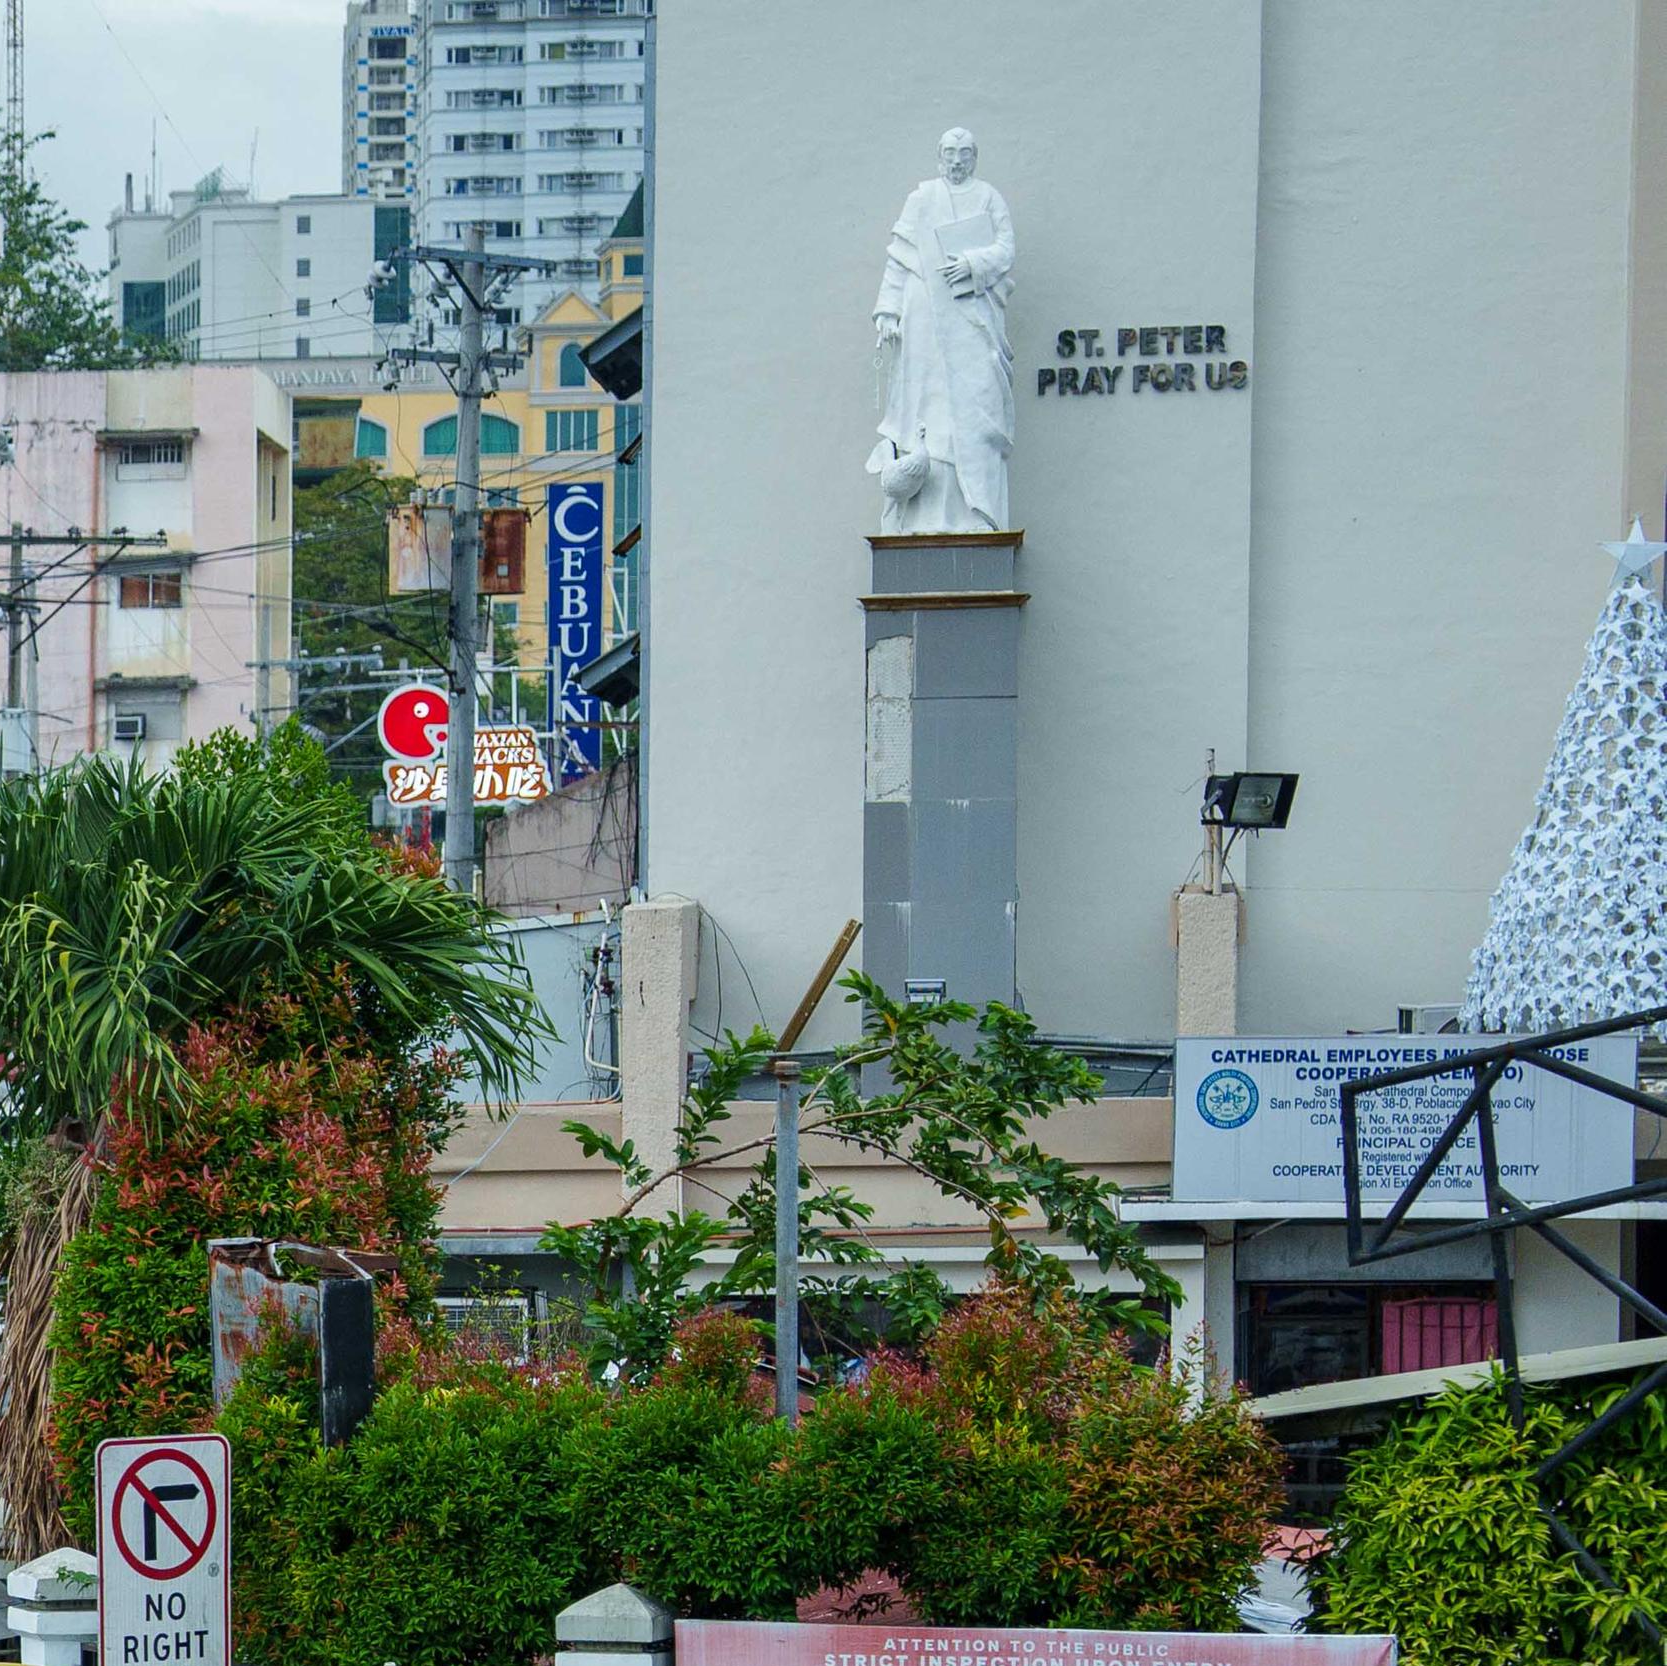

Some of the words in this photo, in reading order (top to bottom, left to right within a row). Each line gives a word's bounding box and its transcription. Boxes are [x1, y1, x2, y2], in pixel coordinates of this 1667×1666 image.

[1056, 330, 1104, 358] ST.
[1118, 325, 1226, 356] PETER
[1037, 366, 1123, 396] PRAY
[1133, 363, 1195, 393] FOR
[1205, 361, 1248, 391] US
[1211, 1049, 1322, 1063] CATHEDRAL
[1327, 1049, 1437, 1063] EMPLOYEES
[1314, 1086, 1336, 1098] San
[1269, 1098, 1292, 1110] San
[1294, 1098, 1327, 1110] Pedro
[1513, 1096, 1535, 1111] City
[1309, 1113, 1337, 1125] CDA
[1368, 1113, 1389, 1125] No.
[1391, 1113, 1409, 1125] RA
[1336, 1137, 1413, 1149] PINCIPAL
[1361, 1151, 1412, 1164] Registered
[1379, 1177, 1391, 1188] XI
[1443, 1177, 1473, 1189] Office
[145, 1593, 186, 1621] NO
[124, 1630, 207, 1665] RIGHT
[883, 1638, 1005, 1655] ATTENTION
[1011, 1641, 1037, 1655] TO
[1045, 1641, 1084, 1655] THE
[1094, 1643, 1168, 1658] PUBLIC
